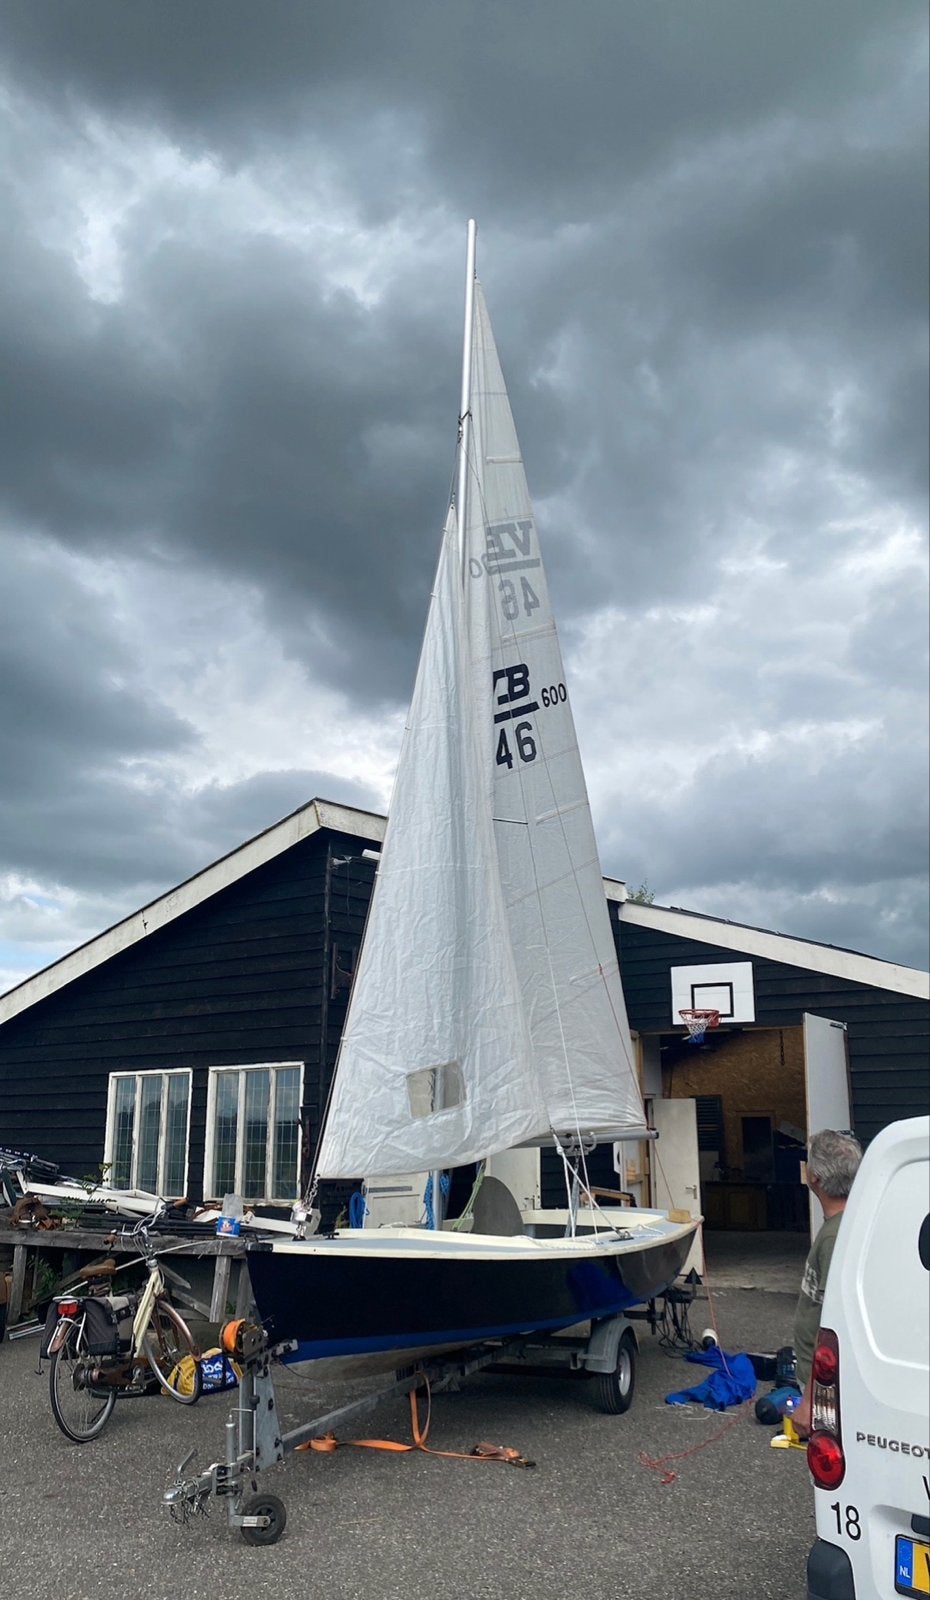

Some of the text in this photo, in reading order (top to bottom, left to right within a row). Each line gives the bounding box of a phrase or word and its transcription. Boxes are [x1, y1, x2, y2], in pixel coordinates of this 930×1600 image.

[541, 682, 567, 708] 600
[496, 721, 537, 769] 46
[830, 1501, 862, 1541] 18
[899, 1565, 912, 1579] NL
